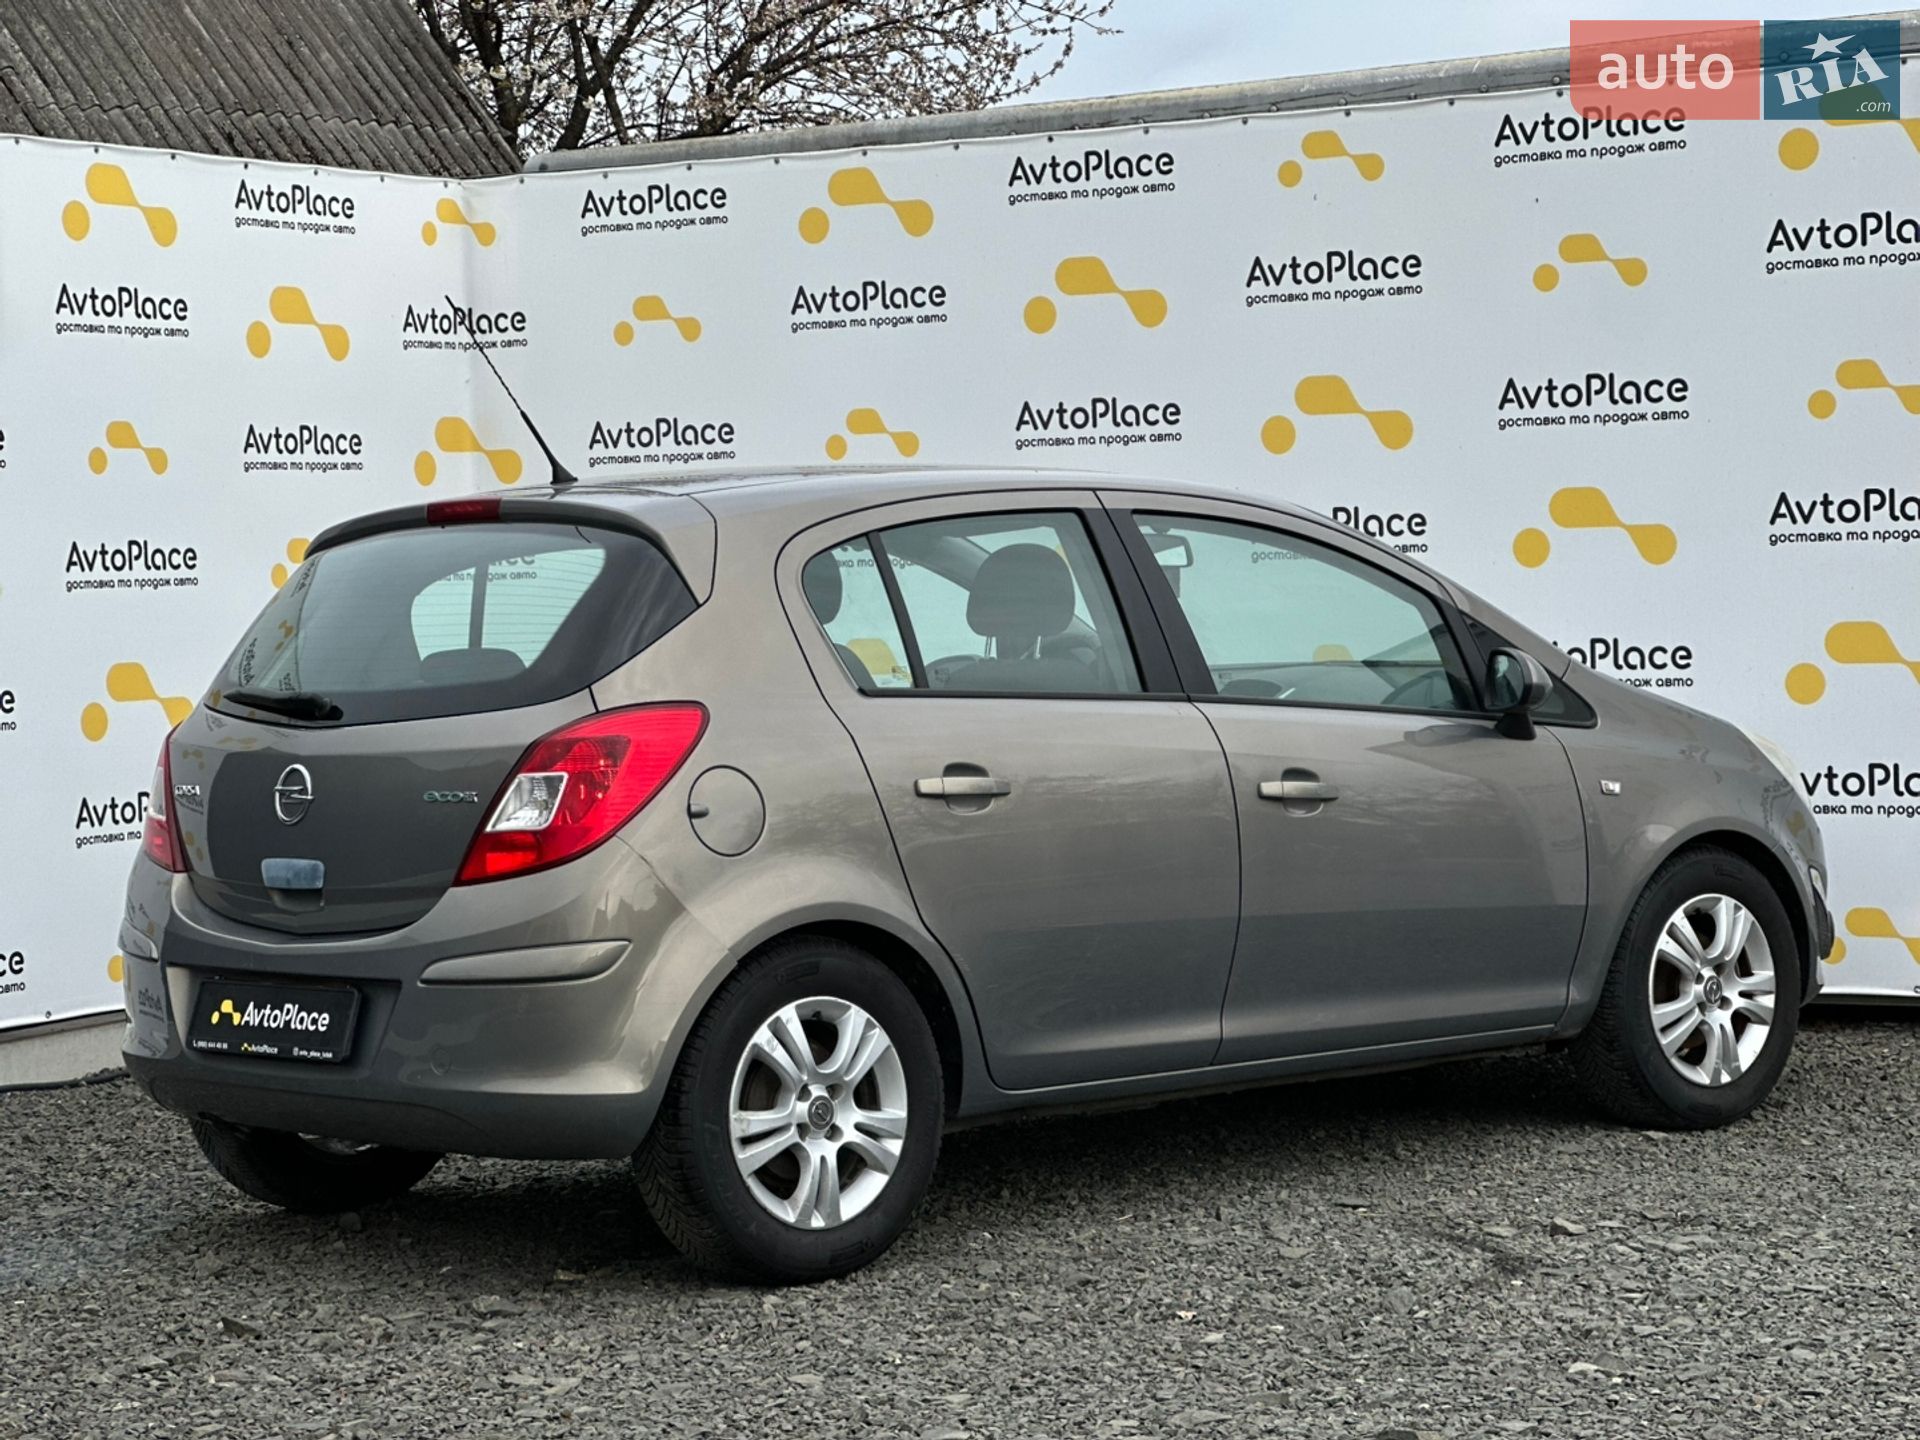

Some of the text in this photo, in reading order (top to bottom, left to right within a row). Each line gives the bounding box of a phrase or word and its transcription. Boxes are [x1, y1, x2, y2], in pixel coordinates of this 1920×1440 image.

[1494, 105, 1687, 147] AvtoPlace
[1494, 138, 1687, 168] доставка та продаж авто
[1008, 150, 1174, 188] AvtoPlace
[235, 179, 354, 219] AvtoPlace
[581, 184, 727, 219] AvtoPlace
[1008, 183, 1175, 205] доставка та продаж авто
[235, 217, 355, 235] доставка та продаж авто
[581, 216, 728, 237] доставка та продаж авто
[1766, 210, 1920, 254] AvtoPla
[1246, 251, 1422, 288] AvtoPlace
[1766, 258, 1839, 274] доставка
[1843, 255, 1865, 267] та
[56, 283, 188, 321] AvtoPlace
[791, 280, 946, 315] AvtoPlace
[1246, 285, 1423, 307] доставка та продаж авто
[56, 322, 189, 338] доставка та продаж авто
[403, 304, 526, 335] AvtoPlace
[791, 314, 947, 333] доставка та продаж авто
[403, 340, 442, 350] доставка
[444, 341, 456, 350] та
[500, 338, 528, 348] авто
[1498, 373, 1689, 411] AvtoPlace
[1015, 398, 1181, 432] AvtoPlace
[1498, 410, 1689, 430] доставка та продаж авто
[244, 424, 362, 455] AvtoPlace
[589, 418, 734, 450] AvtoPlace
[1015, 432, 1182, 450] доставка та продаж авто
[244, 461, 363, 473] доставка та продаж авто
[589, 451, 735, 467] доставка та продаж авто
[1333, 506, 1427, 537] Place
[1769, 488, 1920, 526] AvtoPla
[1769, 529, 1920, 546] доставка та прода
[66, 540, 197, 573] AvtoPlace
[66, 577, 198, 593] доставка та продаж авто
[1655, 677, 1693, 687] авто
[1800, 763, 1920, 797] vtoPla
[1851, 805, 1873, 815] та
[76, 831, 142, 849] доставка та
[241, 1001, 329, 1031] AvtoPlace
